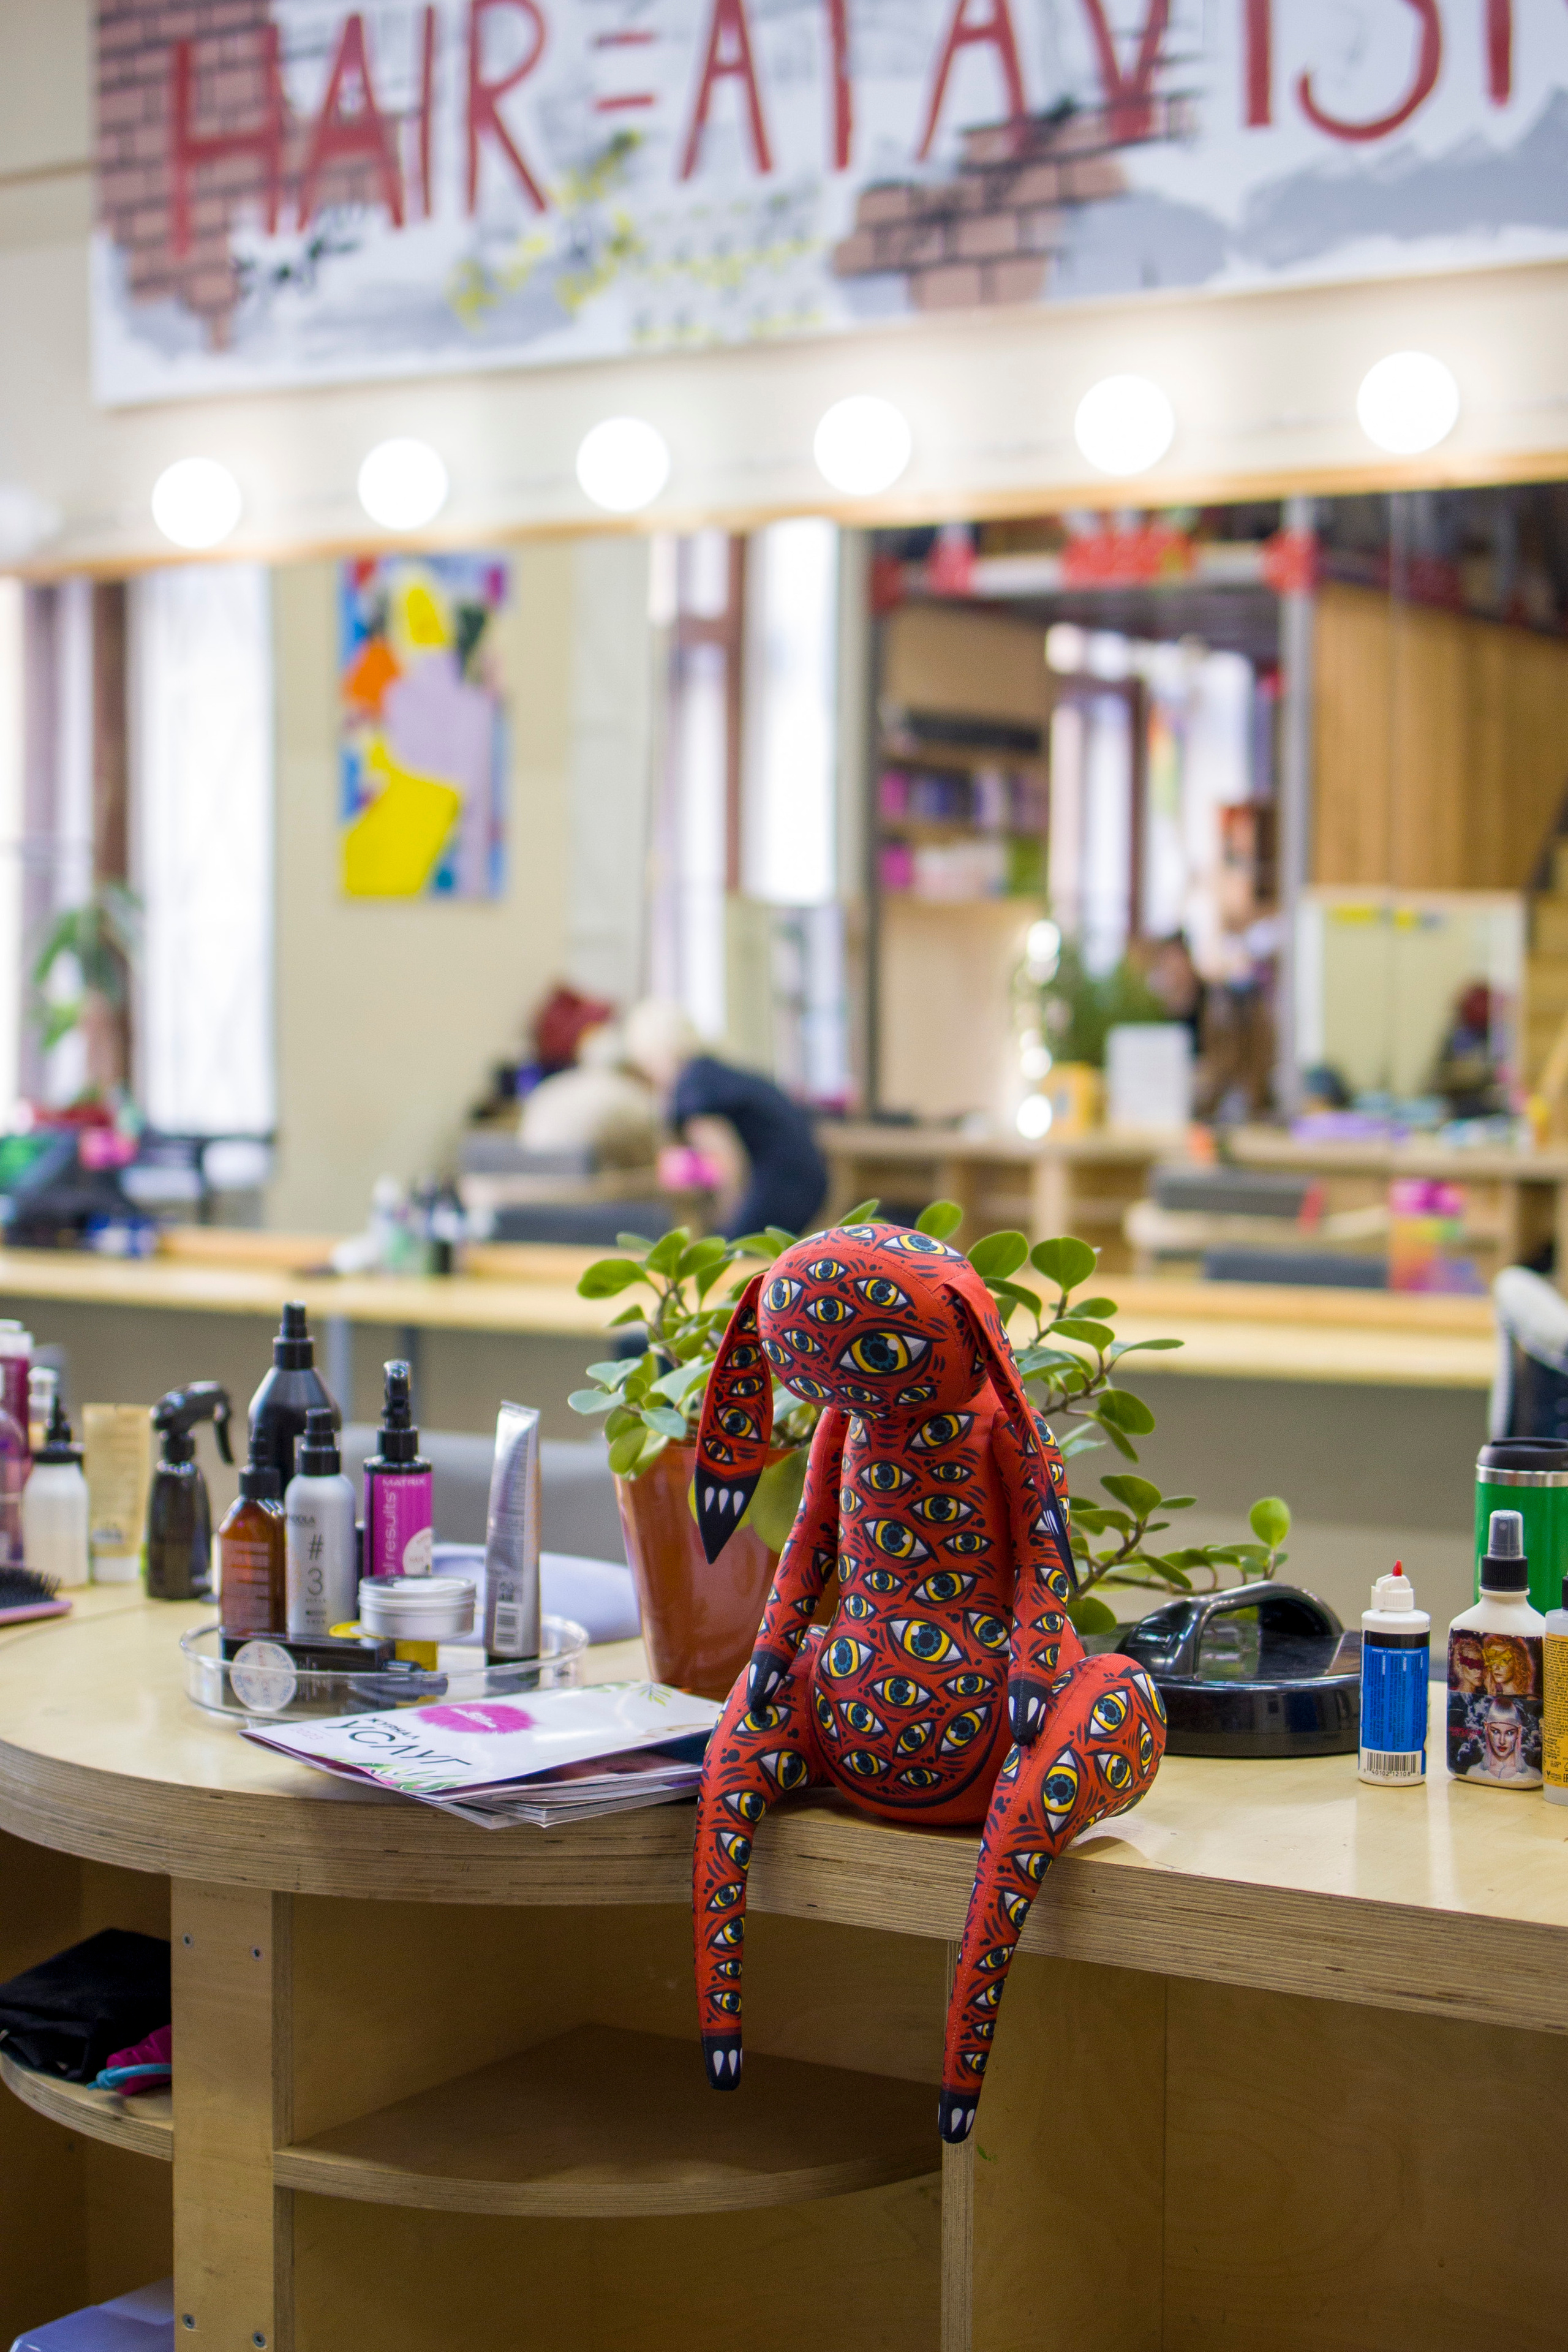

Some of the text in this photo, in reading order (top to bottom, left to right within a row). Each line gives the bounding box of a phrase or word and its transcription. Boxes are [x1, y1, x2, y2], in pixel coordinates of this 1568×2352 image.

[382, 1478, 427, 1488] MATRIX
[309, 1533, 324, 1561] #
[307, 1567, 323, 1596] 3
[366, 1717, 420, 1740] ЖУРНАЛ
[323, 1720, 473, 1766] УСЛУГ
